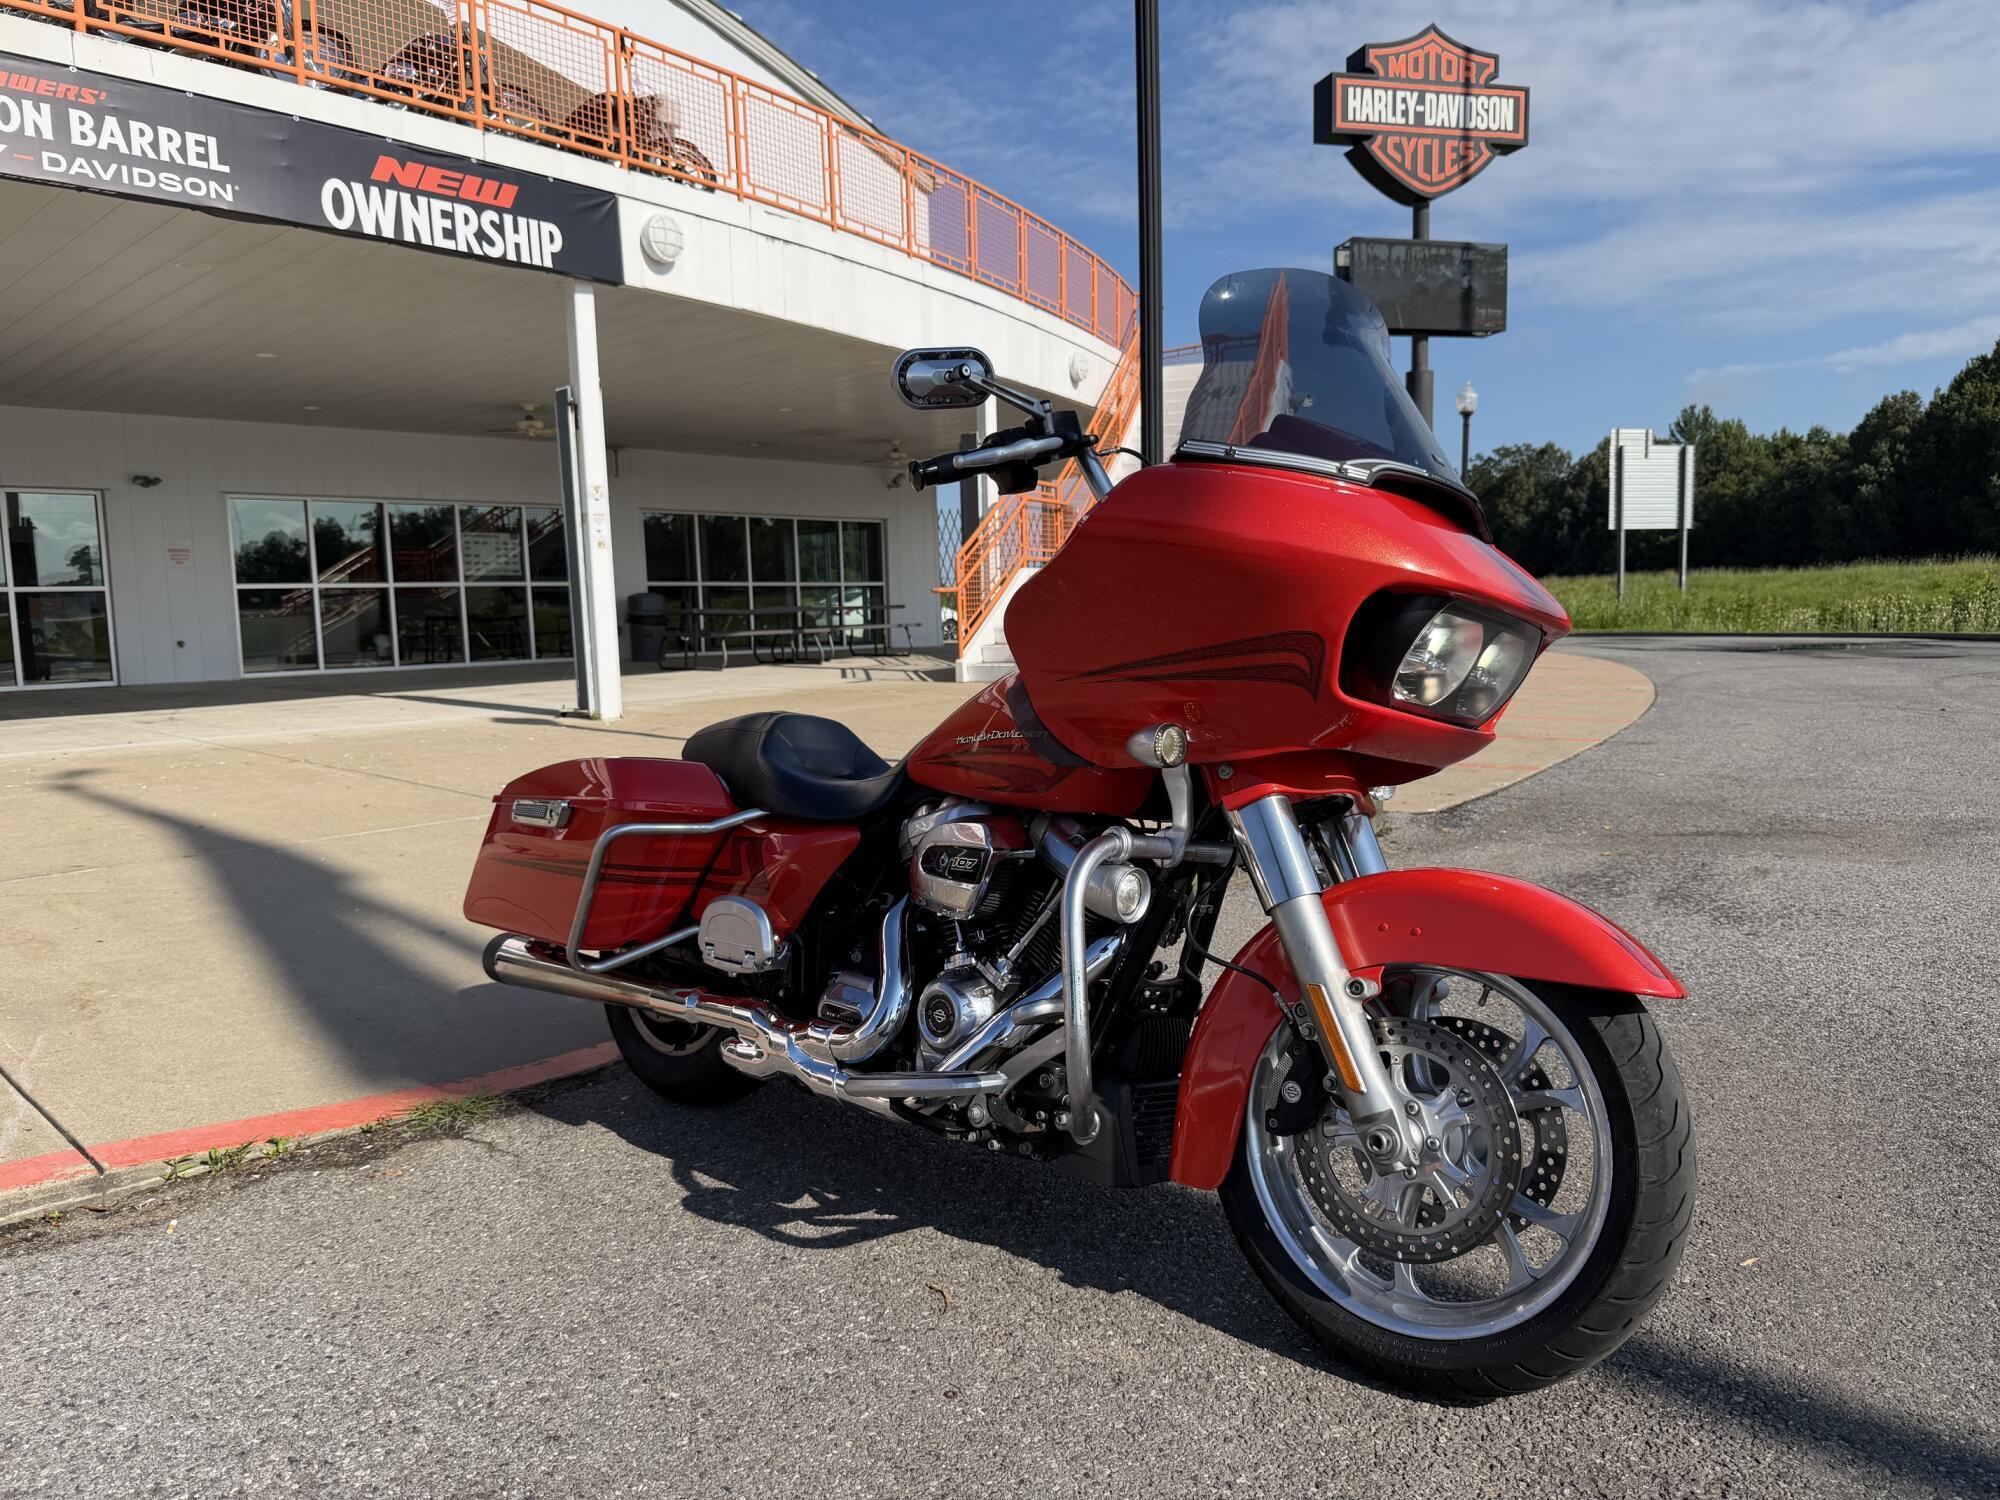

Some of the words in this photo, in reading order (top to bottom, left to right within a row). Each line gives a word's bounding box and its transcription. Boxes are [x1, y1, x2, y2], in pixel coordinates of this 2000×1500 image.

[1388, 42, 1476, 84] MOTOR
[1347, 87, 1514, 131] HARLEY-DAVIDSON
[68, 107, 230, 173] BARREL
[1387, 135, 1475, 182] CYCLES
[370, 155, 519, 209] NEW
[321, 177, 563, 269] OWNERSHIP
[952, 857, 978, 869] 107
